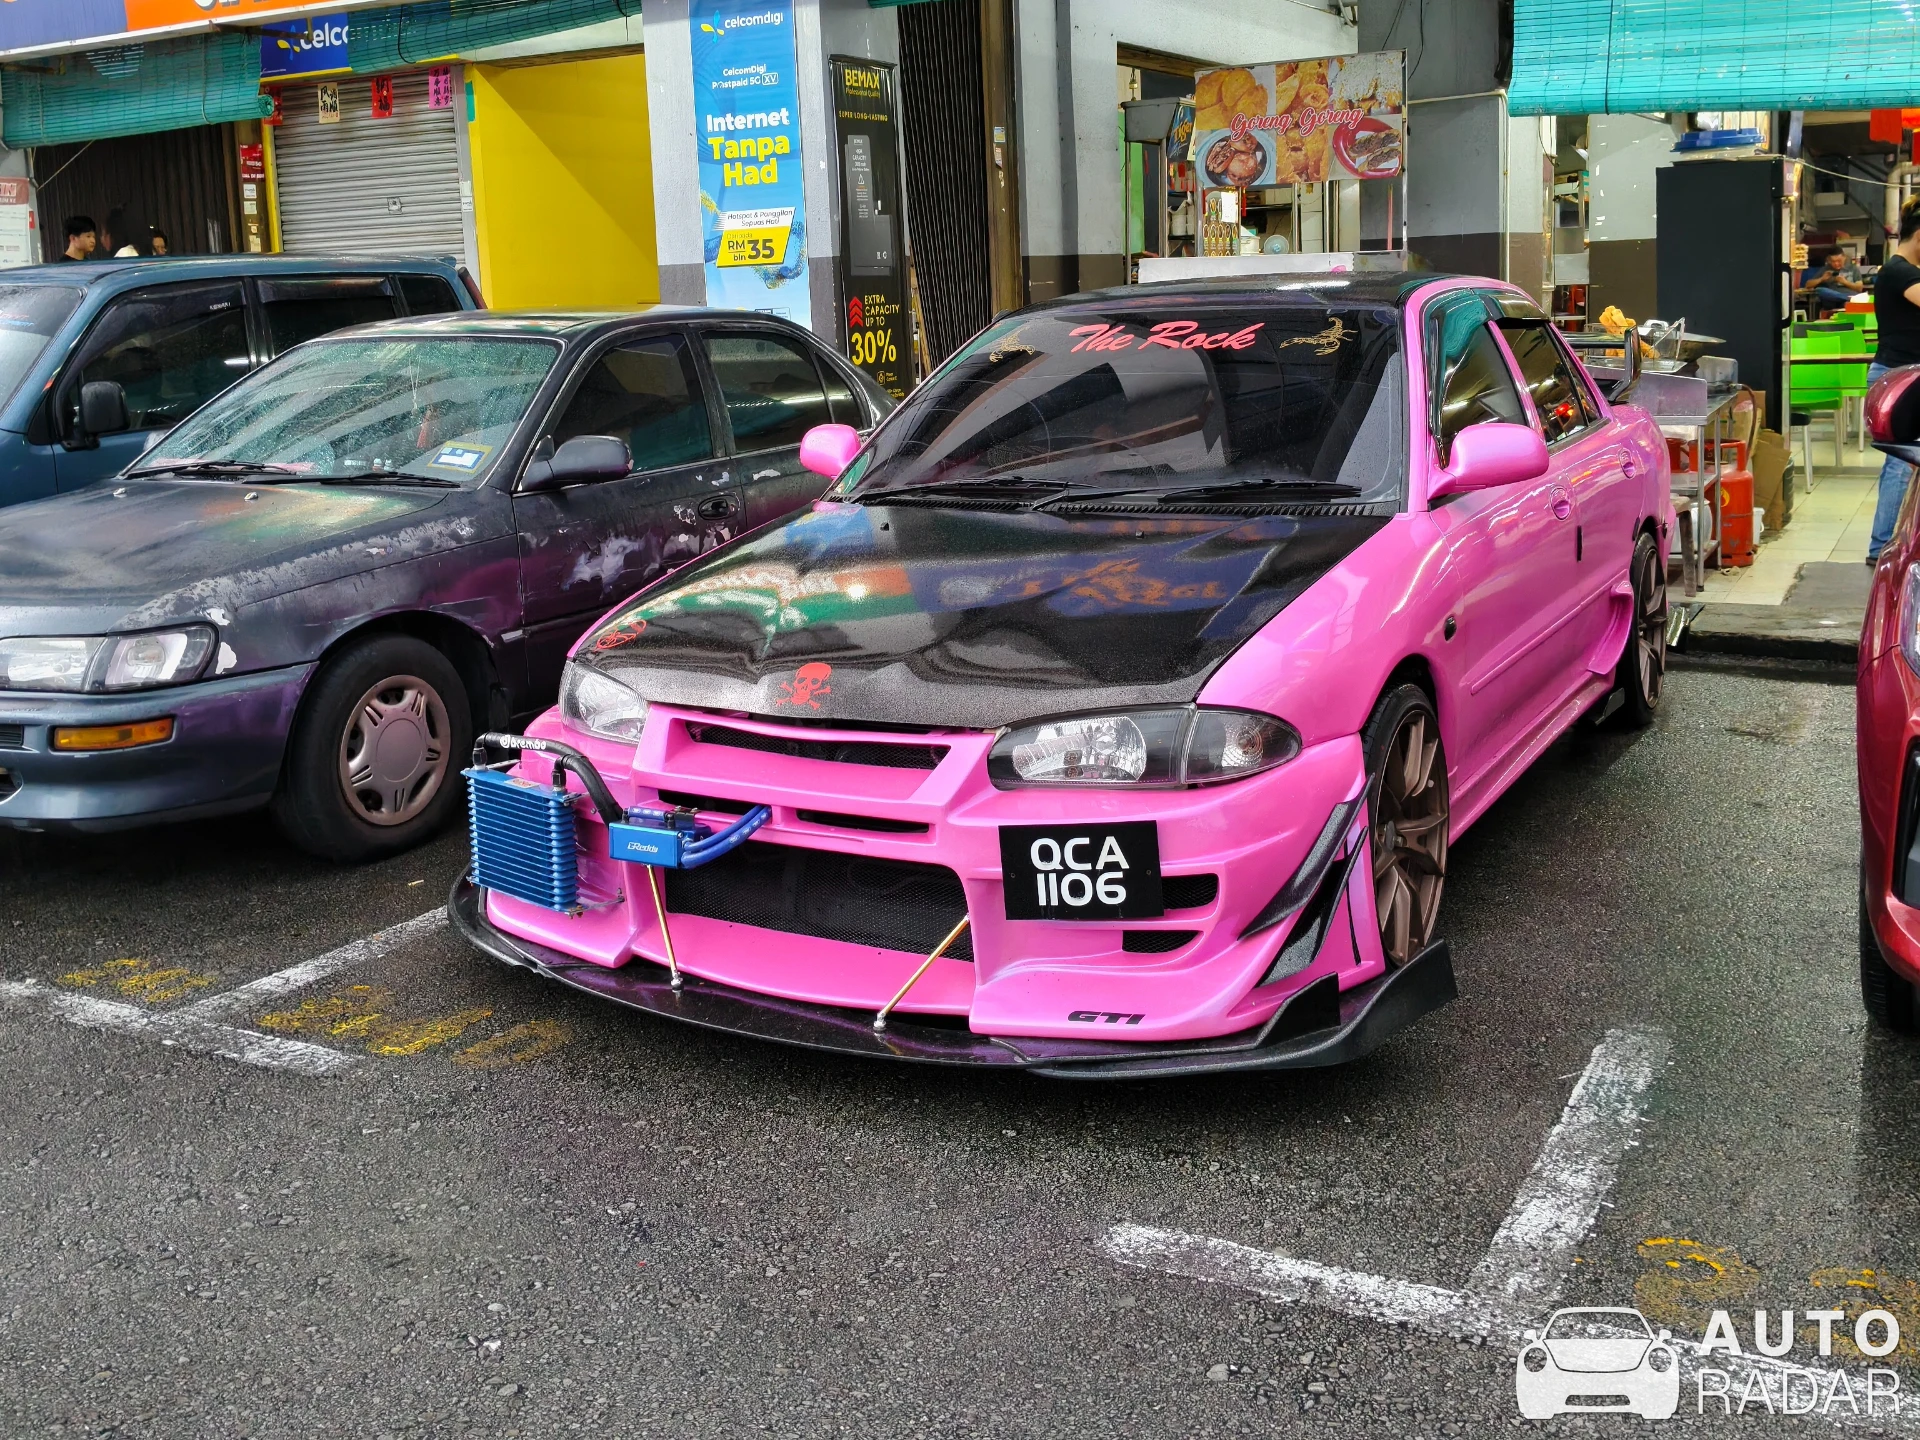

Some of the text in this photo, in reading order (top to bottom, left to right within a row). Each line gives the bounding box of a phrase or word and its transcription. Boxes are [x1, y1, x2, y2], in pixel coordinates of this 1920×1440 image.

[724, 11, 784, 29] celcomdigi
[722, 64, 767, 77] CelcomDigi
[845, 69, 880, 90] BEMAX
[712, 77, 748, 90] Postpaid
[763, 74, 777, 84] XV
[706, 107, 791, 133] Internet
[838, 110, 889, 122] SUPER LONG-LASTING
[1231, 106, 1365, 142] Goreng Goreng
[1173, 118, 1194, 143] Tiger
[707, 135, 791, 162] Tanpa
[723, 157, 779, 188] Had
[727, 212, 753, 221] Hotspot
[754, 211, 759, 219] &
[727, 238, 775, 260] RM 35
[733, 254, 746, 262] bln
[864, 294, 886, 305] EXTRA
[865, 304, 900, 316] CAPACITY
[865, 316, 886, 328] UP TO
[1068, 320, 1265, 353] The Rock
[851, 328, 897, 366] 30%
[510, 736, 547, 750] brembo
[1030, 836, 1130, 870] QCA
[1036, 871, 1127, 907] 1106
[1067, 1010, 1146, 1025] GTI
